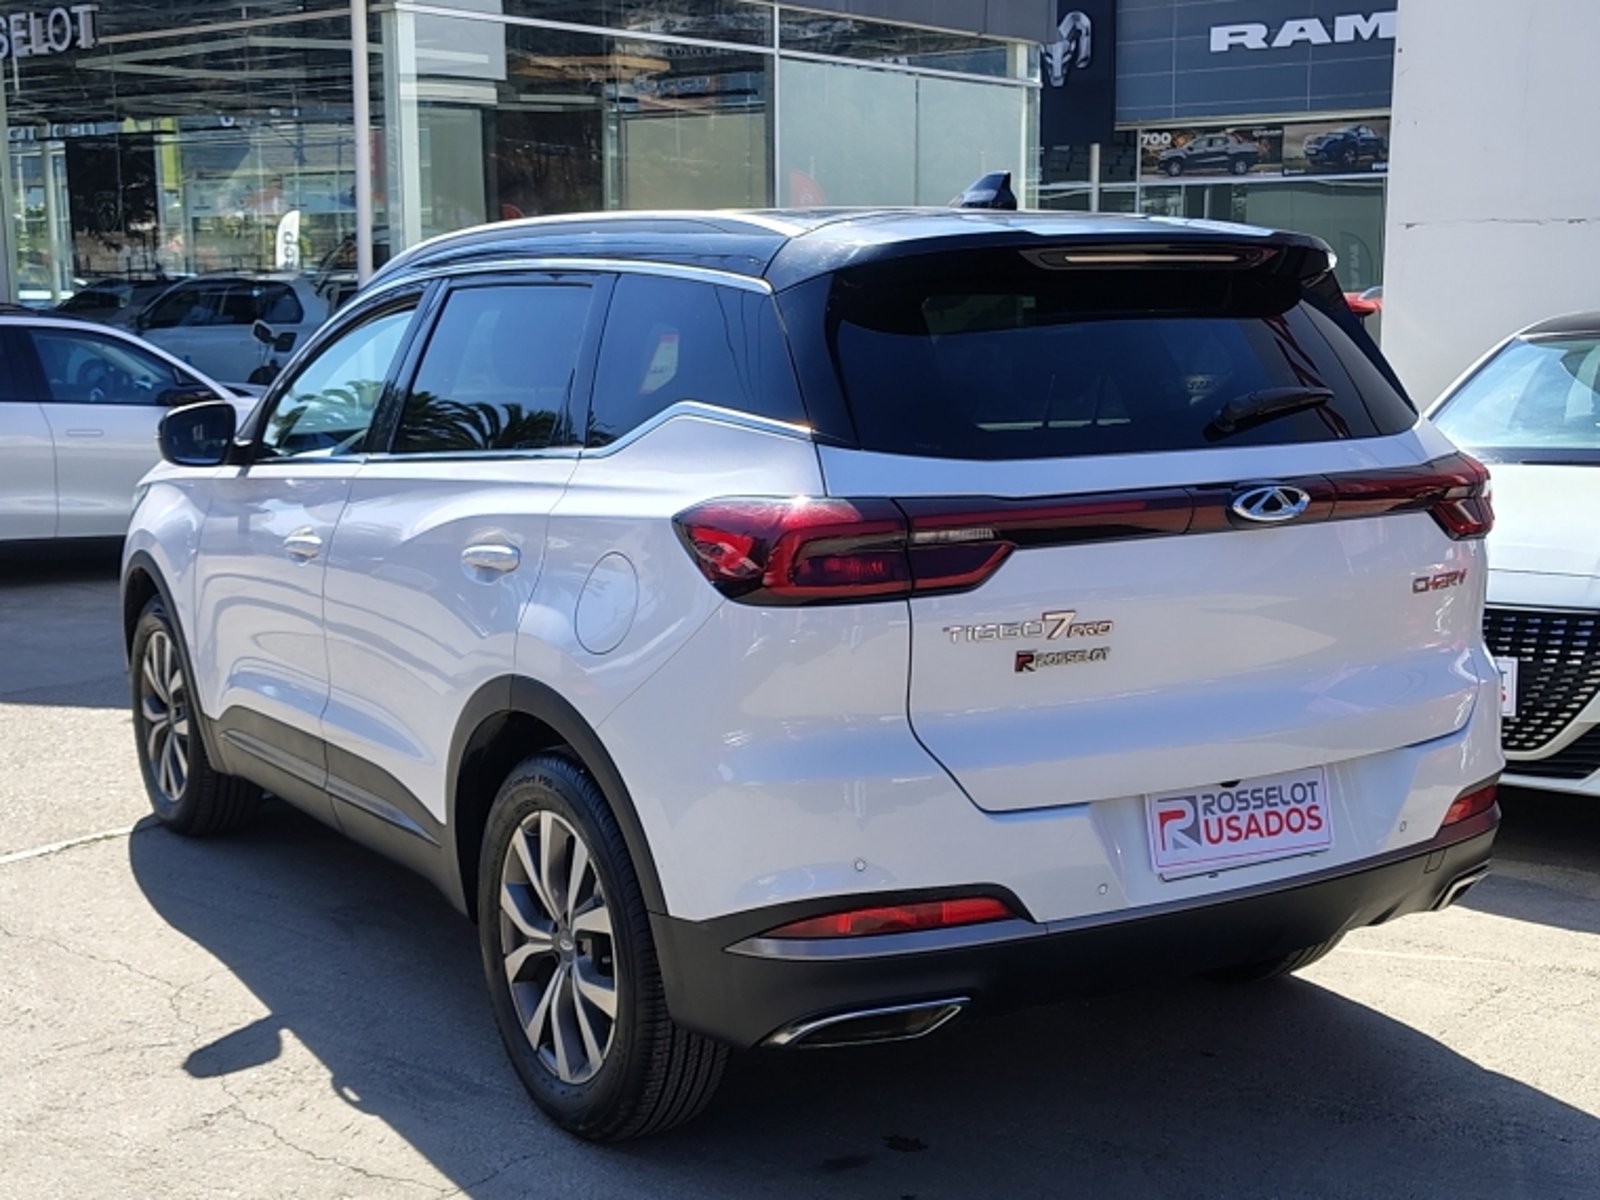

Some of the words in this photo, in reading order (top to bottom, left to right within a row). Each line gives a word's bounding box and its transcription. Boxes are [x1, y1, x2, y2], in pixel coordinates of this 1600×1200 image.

[1210, 10, 1397, 52] RAM
[1141, 132, 1172, 145] 700
[1412, 568, 1468, 594] CHERY
[1201, 781, 1318, 816] ROSSELOT
[1203, 804, 1323, 845] USADOS
